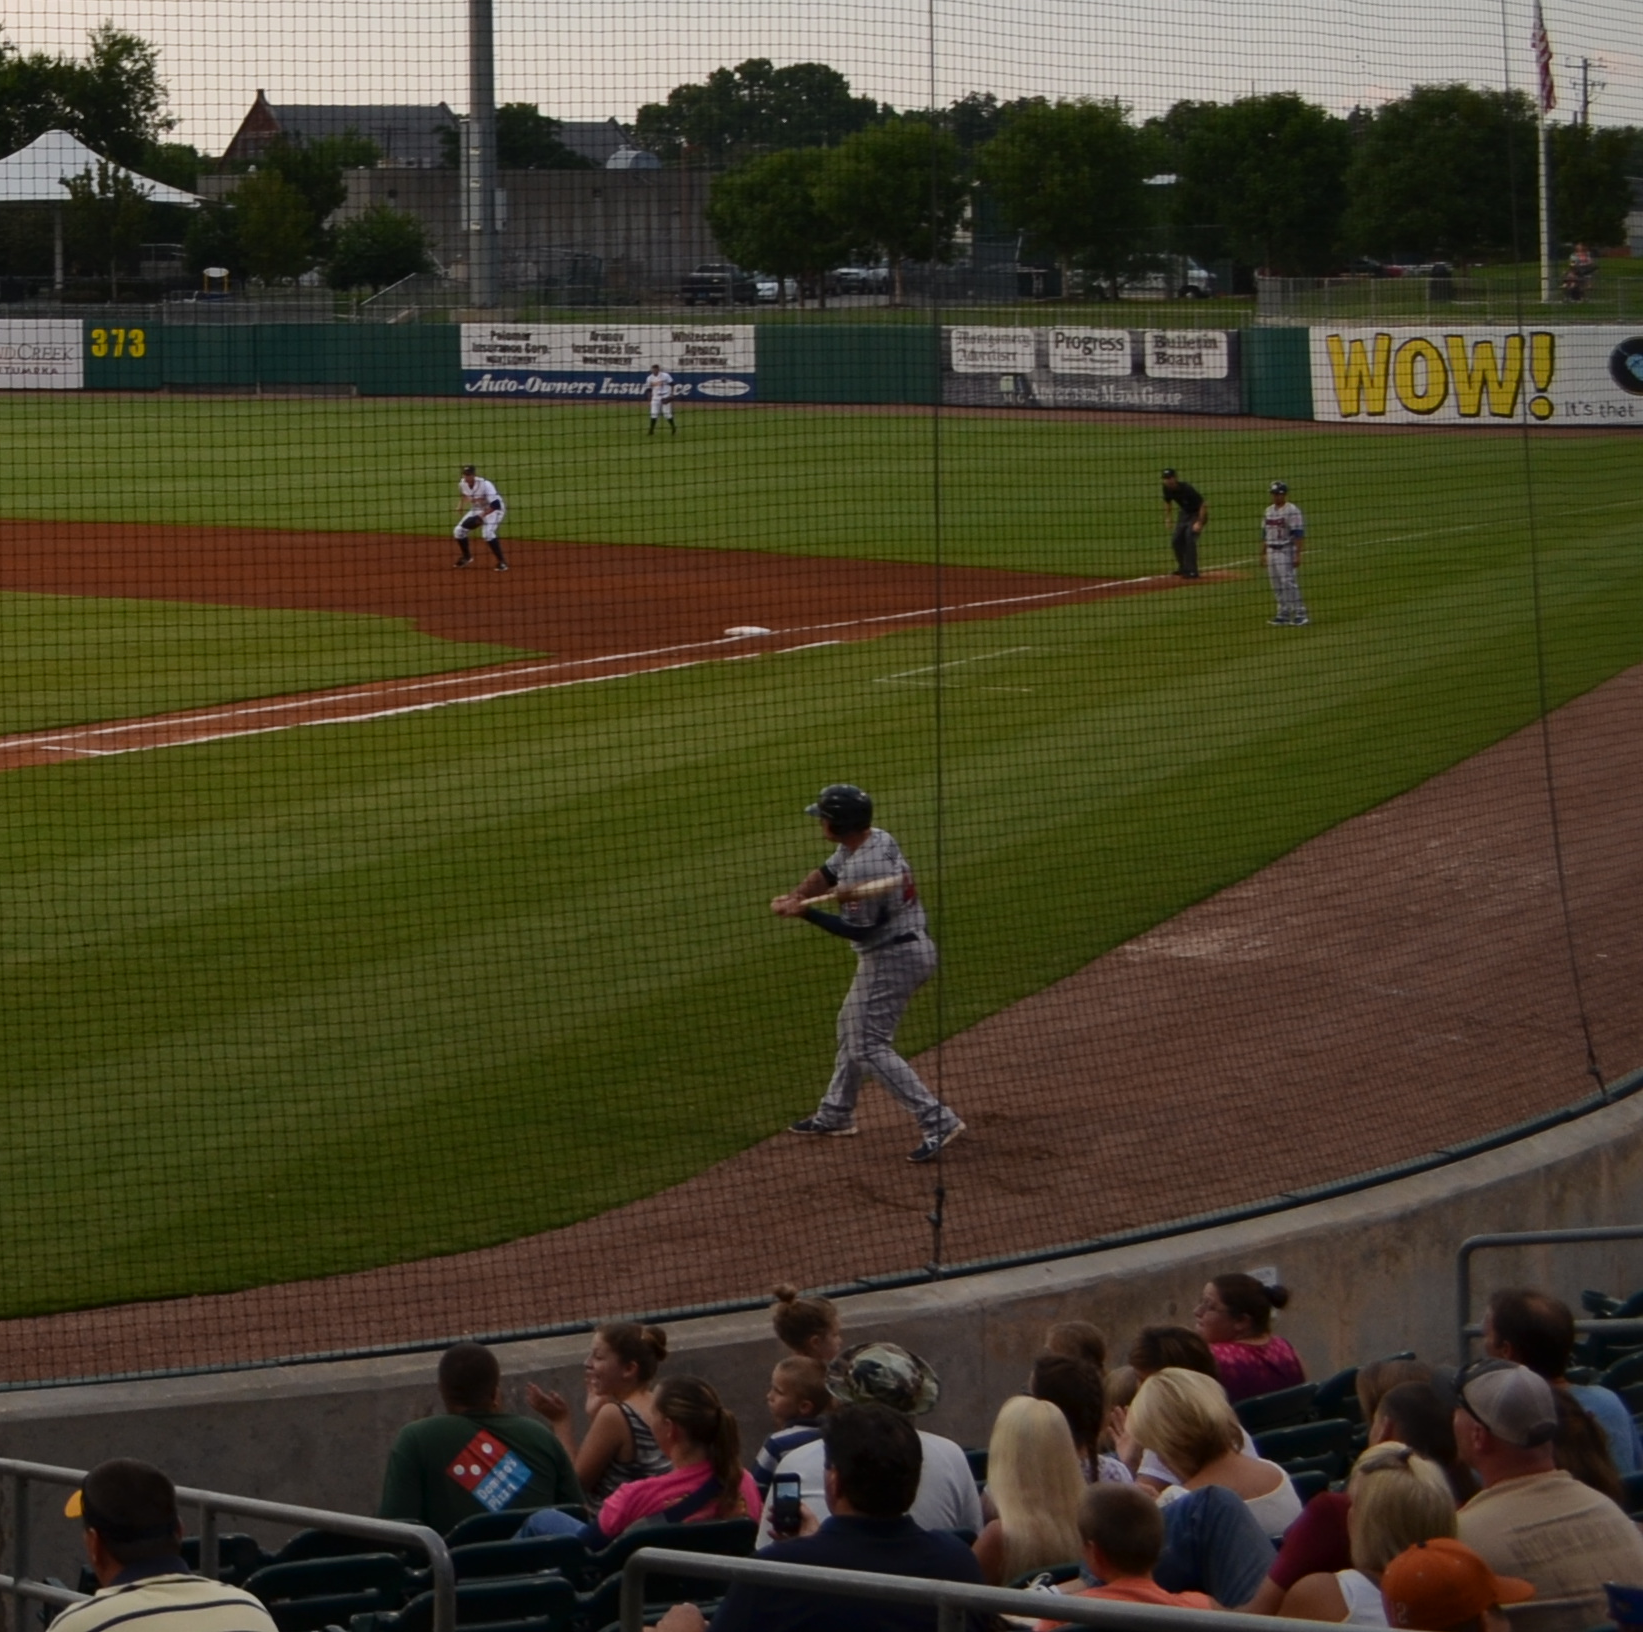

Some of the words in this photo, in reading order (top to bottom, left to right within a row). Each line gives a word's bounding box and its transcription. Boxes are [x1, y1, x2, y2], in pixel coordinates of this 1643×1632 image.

[91, 328, 147, 358] 373
[1054, 332, 1124, 356] Progress
[1153, 335, 1218, 350] Bulletin
[1155, 351, 1203, 366] Board
[465, 373, 596, 395] Auto-Owners
[599, 377, 693, 399] Insurce
[1326, 331, 1555, 421] WOW!
[1600, 401, 1636, 418] that
